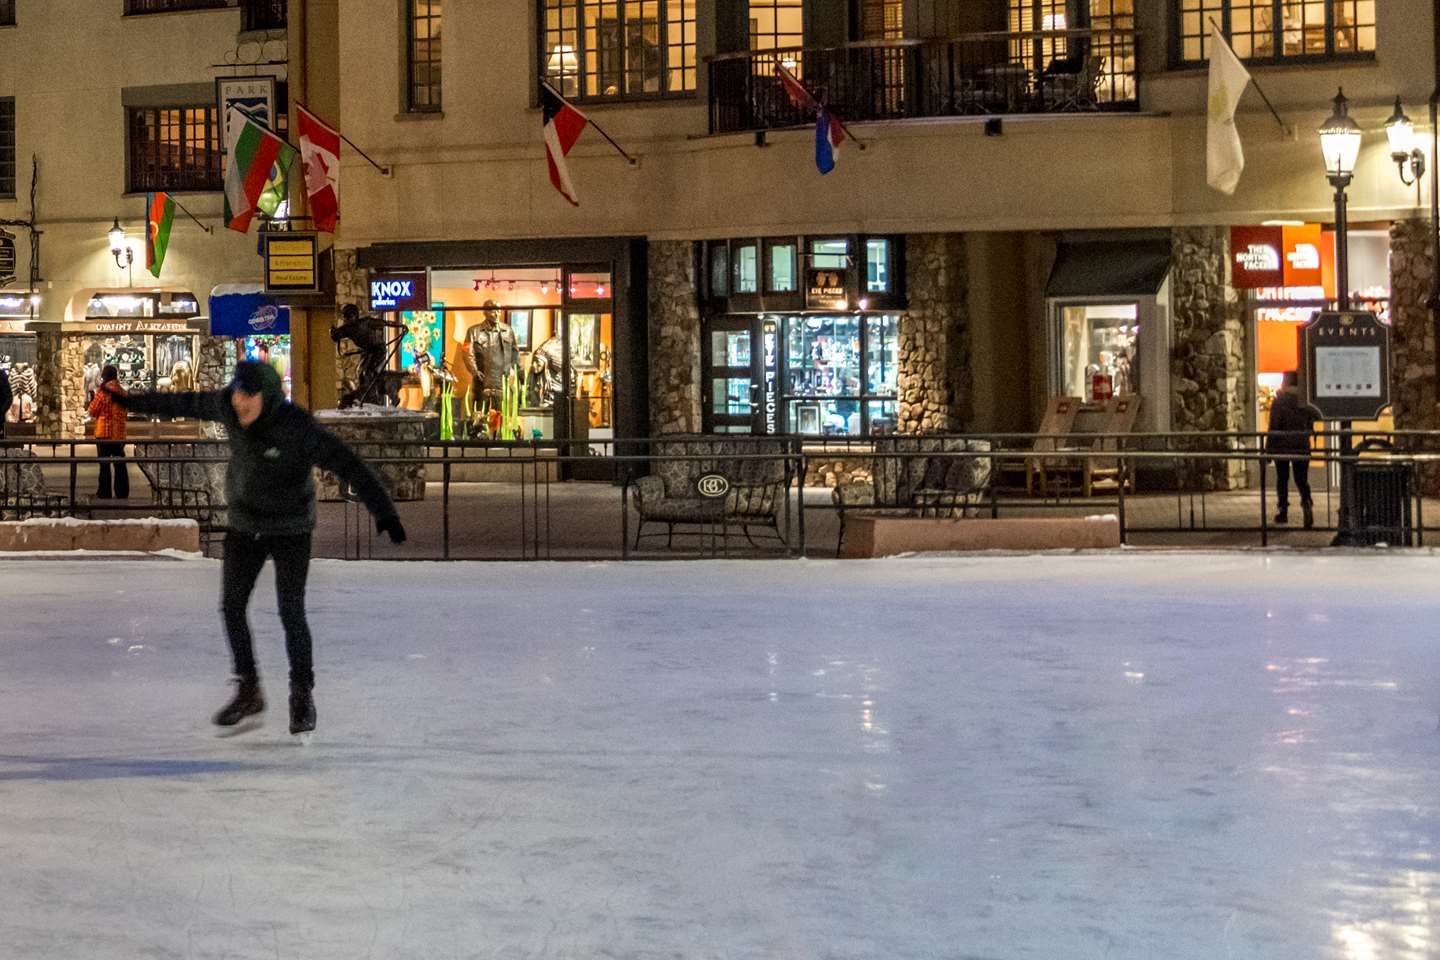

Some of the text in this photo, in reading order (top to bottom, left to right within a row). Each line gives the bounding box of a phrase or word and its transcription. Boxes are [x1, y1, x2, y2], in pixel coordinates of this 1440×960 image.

[226, 86, 268, 95] PARK
[371, 281, 411, 297] KNOX
[95, 322, 132, 331] OVANNY
[1318, 327, 1376, 336] EVENTS
[764, 371, 776, 434] PIECES
